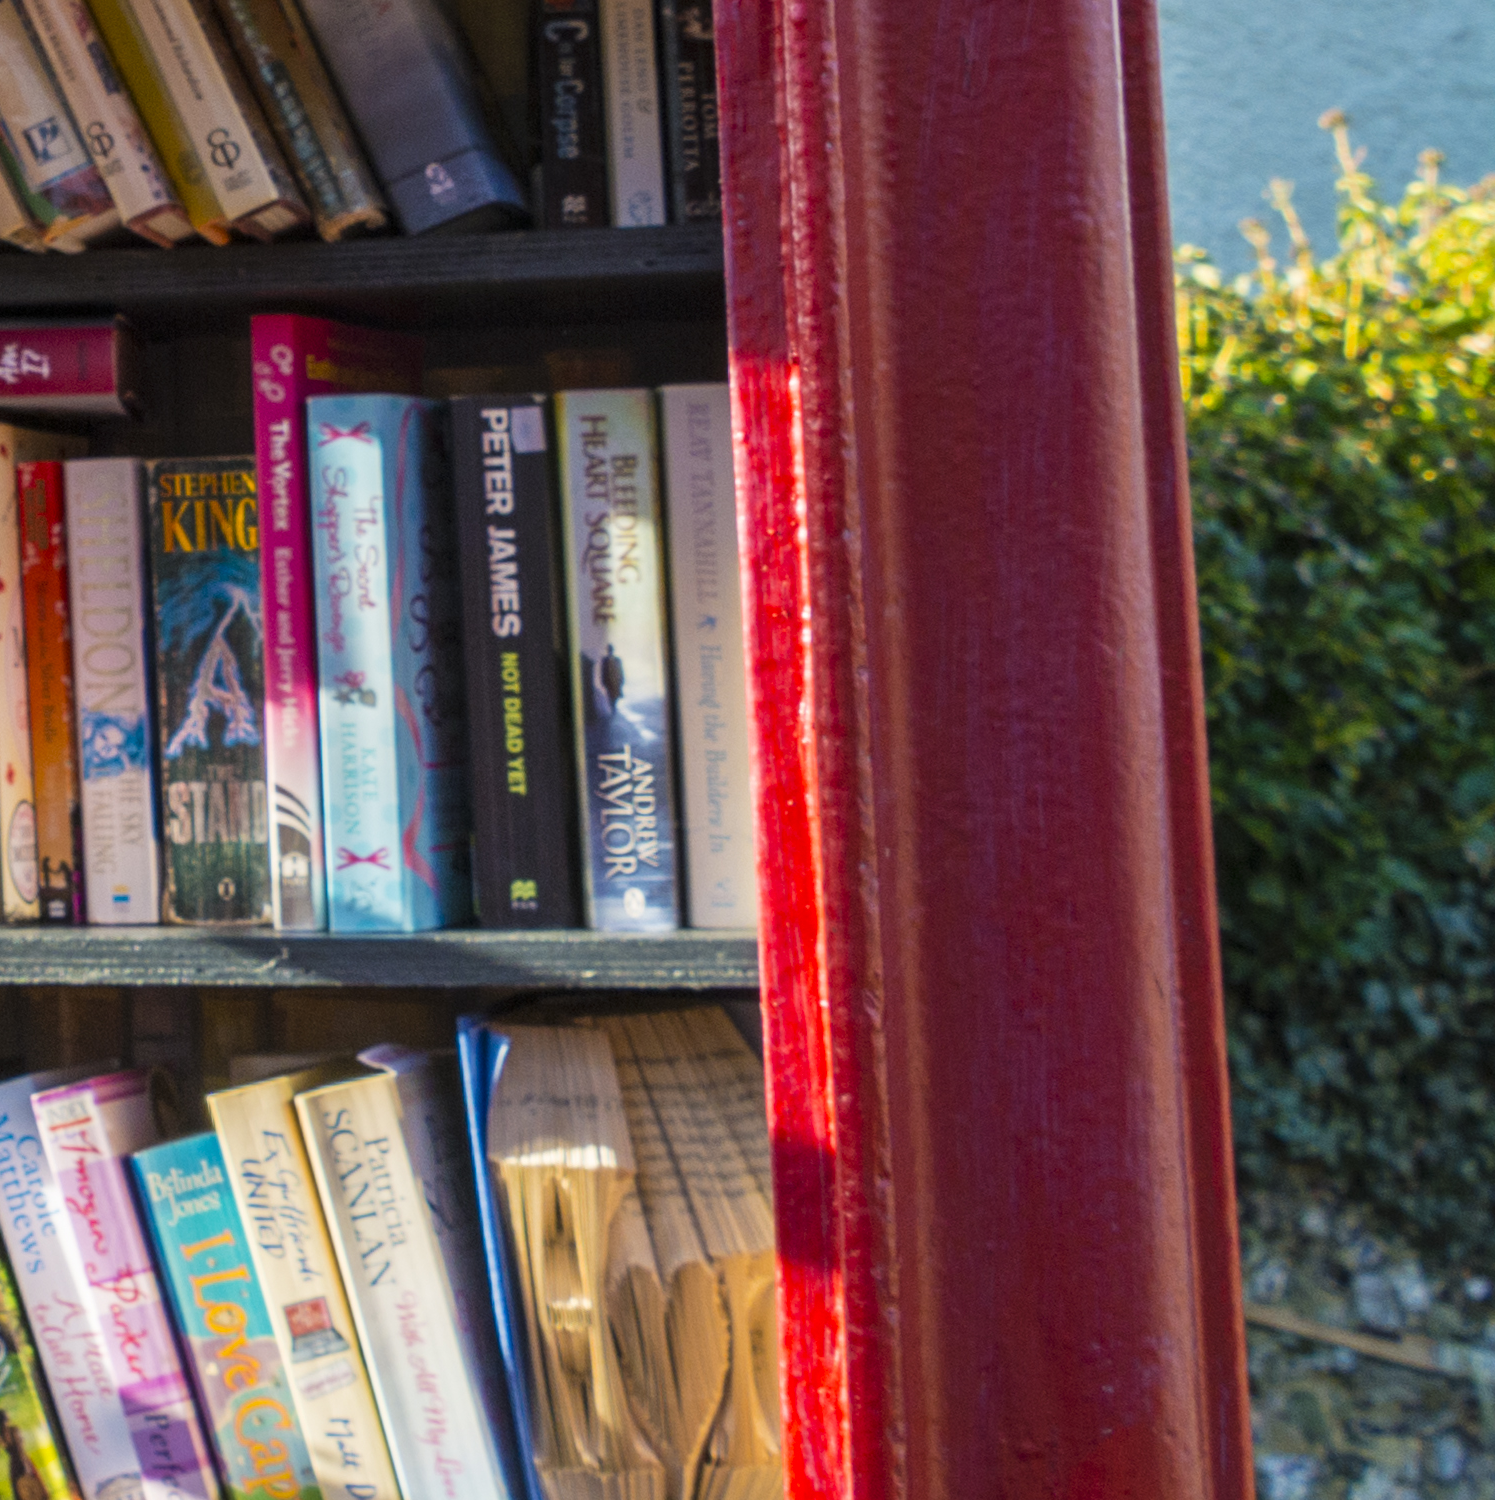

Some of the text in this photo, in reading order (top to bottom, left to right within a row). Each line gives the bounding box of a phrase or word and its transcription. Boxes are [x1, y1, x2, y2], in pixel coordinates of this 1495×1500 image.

[677, 59, 701, 170] PERROTTA
[700, 91, 716, 138] TOM
[159, 470, 257, 497] STEPHEN
[162, 497, 257, 553] KING
[267, 420, 294, 531] The Vortex
[480, 407, 522, 638] PETER JAMES
[575, 413, 622, 626] HEART SQUARE
[604, 454, 649, 585] BLEEDING
[71, 490, 143, 713] SHELDON
[337, 723, 360, 835] HARRISON
[360, 747, 379, 810] KATE
[498, 651, 526, 796] NOT DEAD YET
[590, 745, 643, 880] TAYLOR
[627, 754, 663, 869] ANDREW
[13, 1131, 64, 1239] Carole
[146, 1160, 223, 1202] Belinda
[168, 1190, 221, 1227] Jones
[237, 1155, 286, 1263] UNITED
[315, 1104, 402, 1291] SCANLAN
[360, 1134, 419, 1248] Patricia
[179, 1228, 235, 1262] I
[187, 1258, 284, 1395] Love
